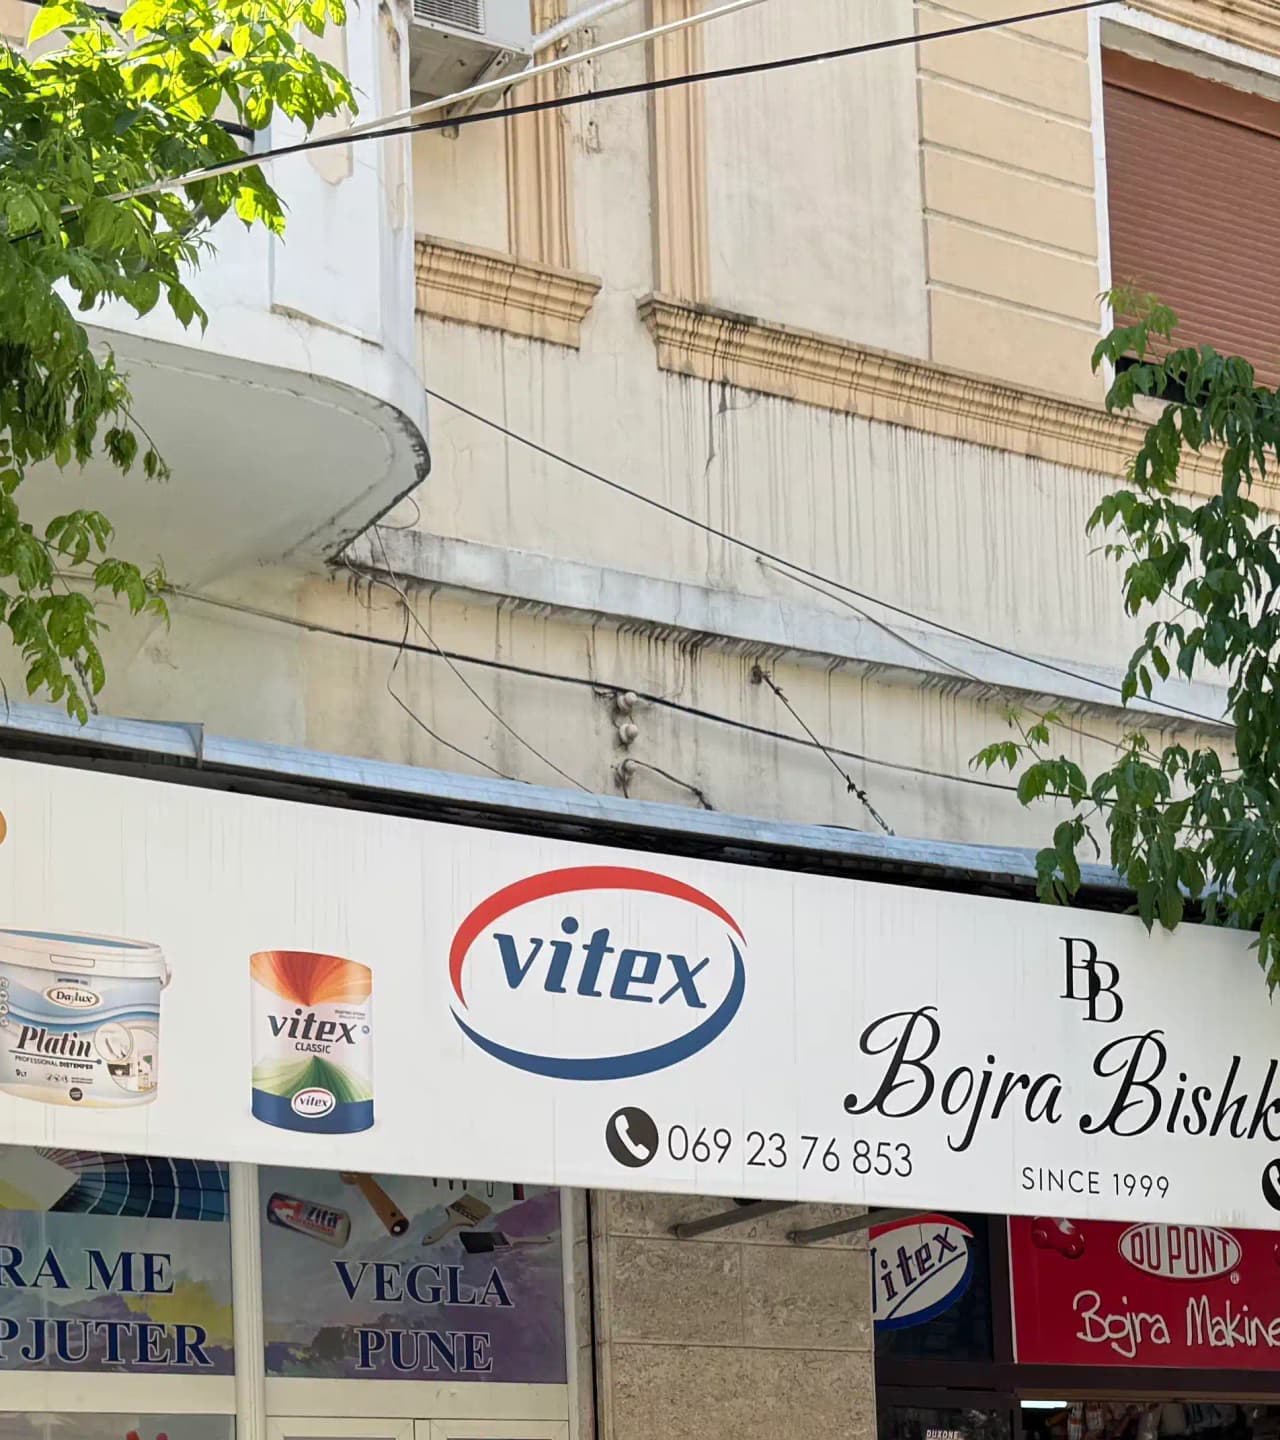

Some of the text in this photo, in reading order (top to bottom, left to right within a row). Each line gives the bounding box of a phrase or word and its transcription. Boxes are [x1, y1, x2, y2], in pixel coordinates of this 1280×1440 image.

[493, 916, 710, 1009] vitex
[17, 1025, 93, 1058] Platin
[267, 1008, 357, 1045] vitex
[295, 1041, 332, 1054] CLASSIC
[298, 1095, 329, 1108] vitex
[843, 1005, 1062, 1152] Bojra
[668, 1124, 913, 1178] 069 23 76 853
[1021, 1167, 1170, 1199] SINCE 1999
[87, 1249, 175, 1295] ME
[335, 1260, 513, 1308] VEGLA
[1073, 1290, 1170, 1358] Bojra
[355, 1327, 494, 1373] PUNE
